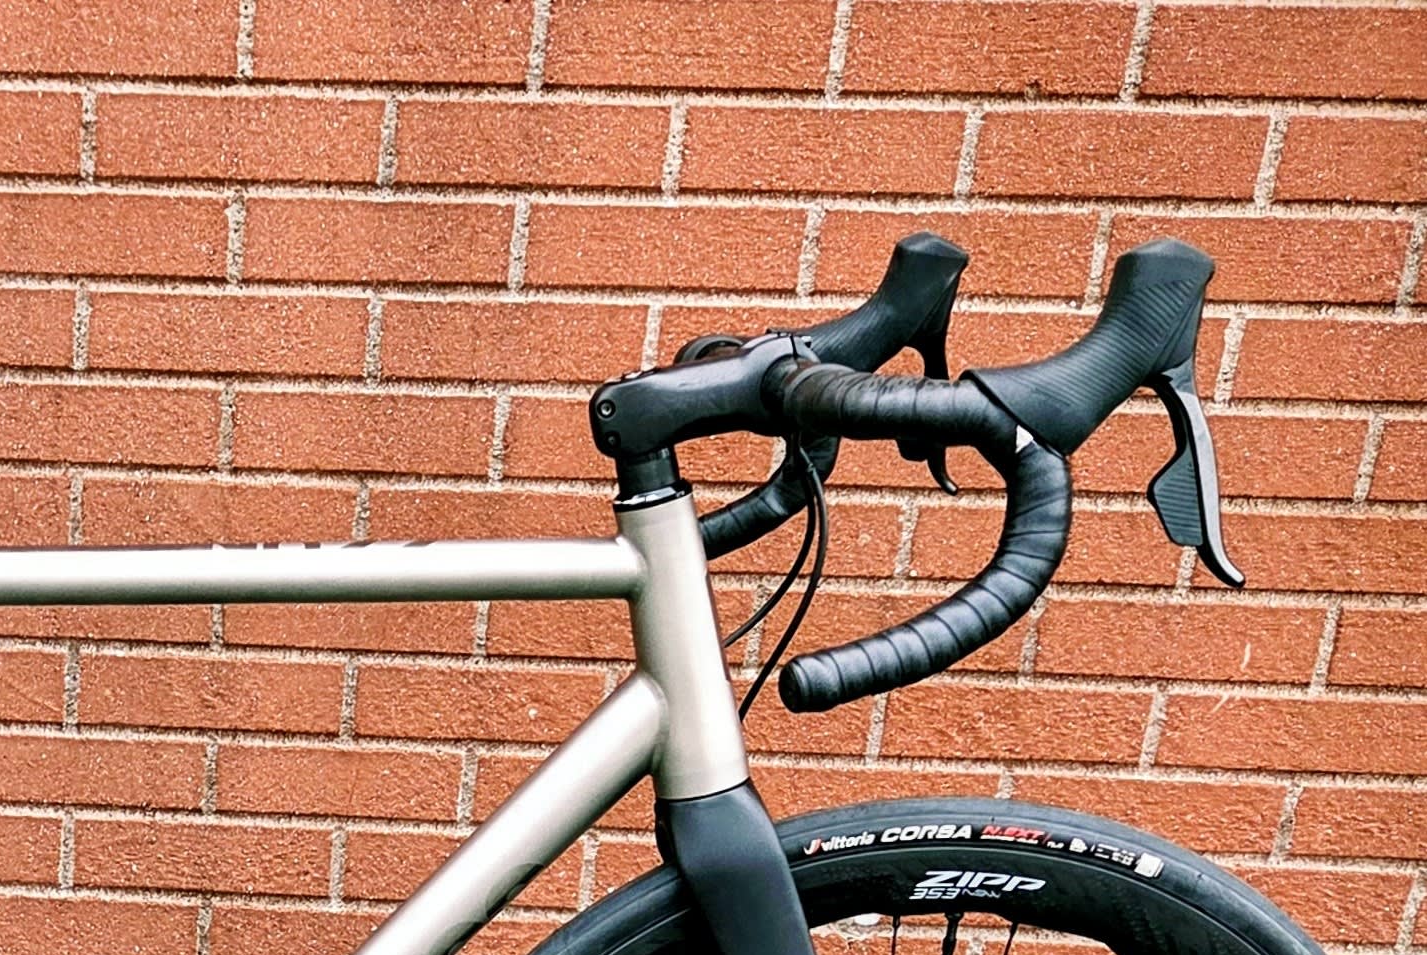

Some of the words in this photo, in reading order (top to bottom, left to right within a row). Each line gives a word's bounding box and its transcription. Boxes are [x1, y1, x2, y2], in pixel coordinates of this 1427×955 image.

[820, 831, 876, 851] vittoria
[880, 824, 973, 843] CORSA
[915, 870, 1046, 892] ZIPP
[909, 887, 961, 900] 353
